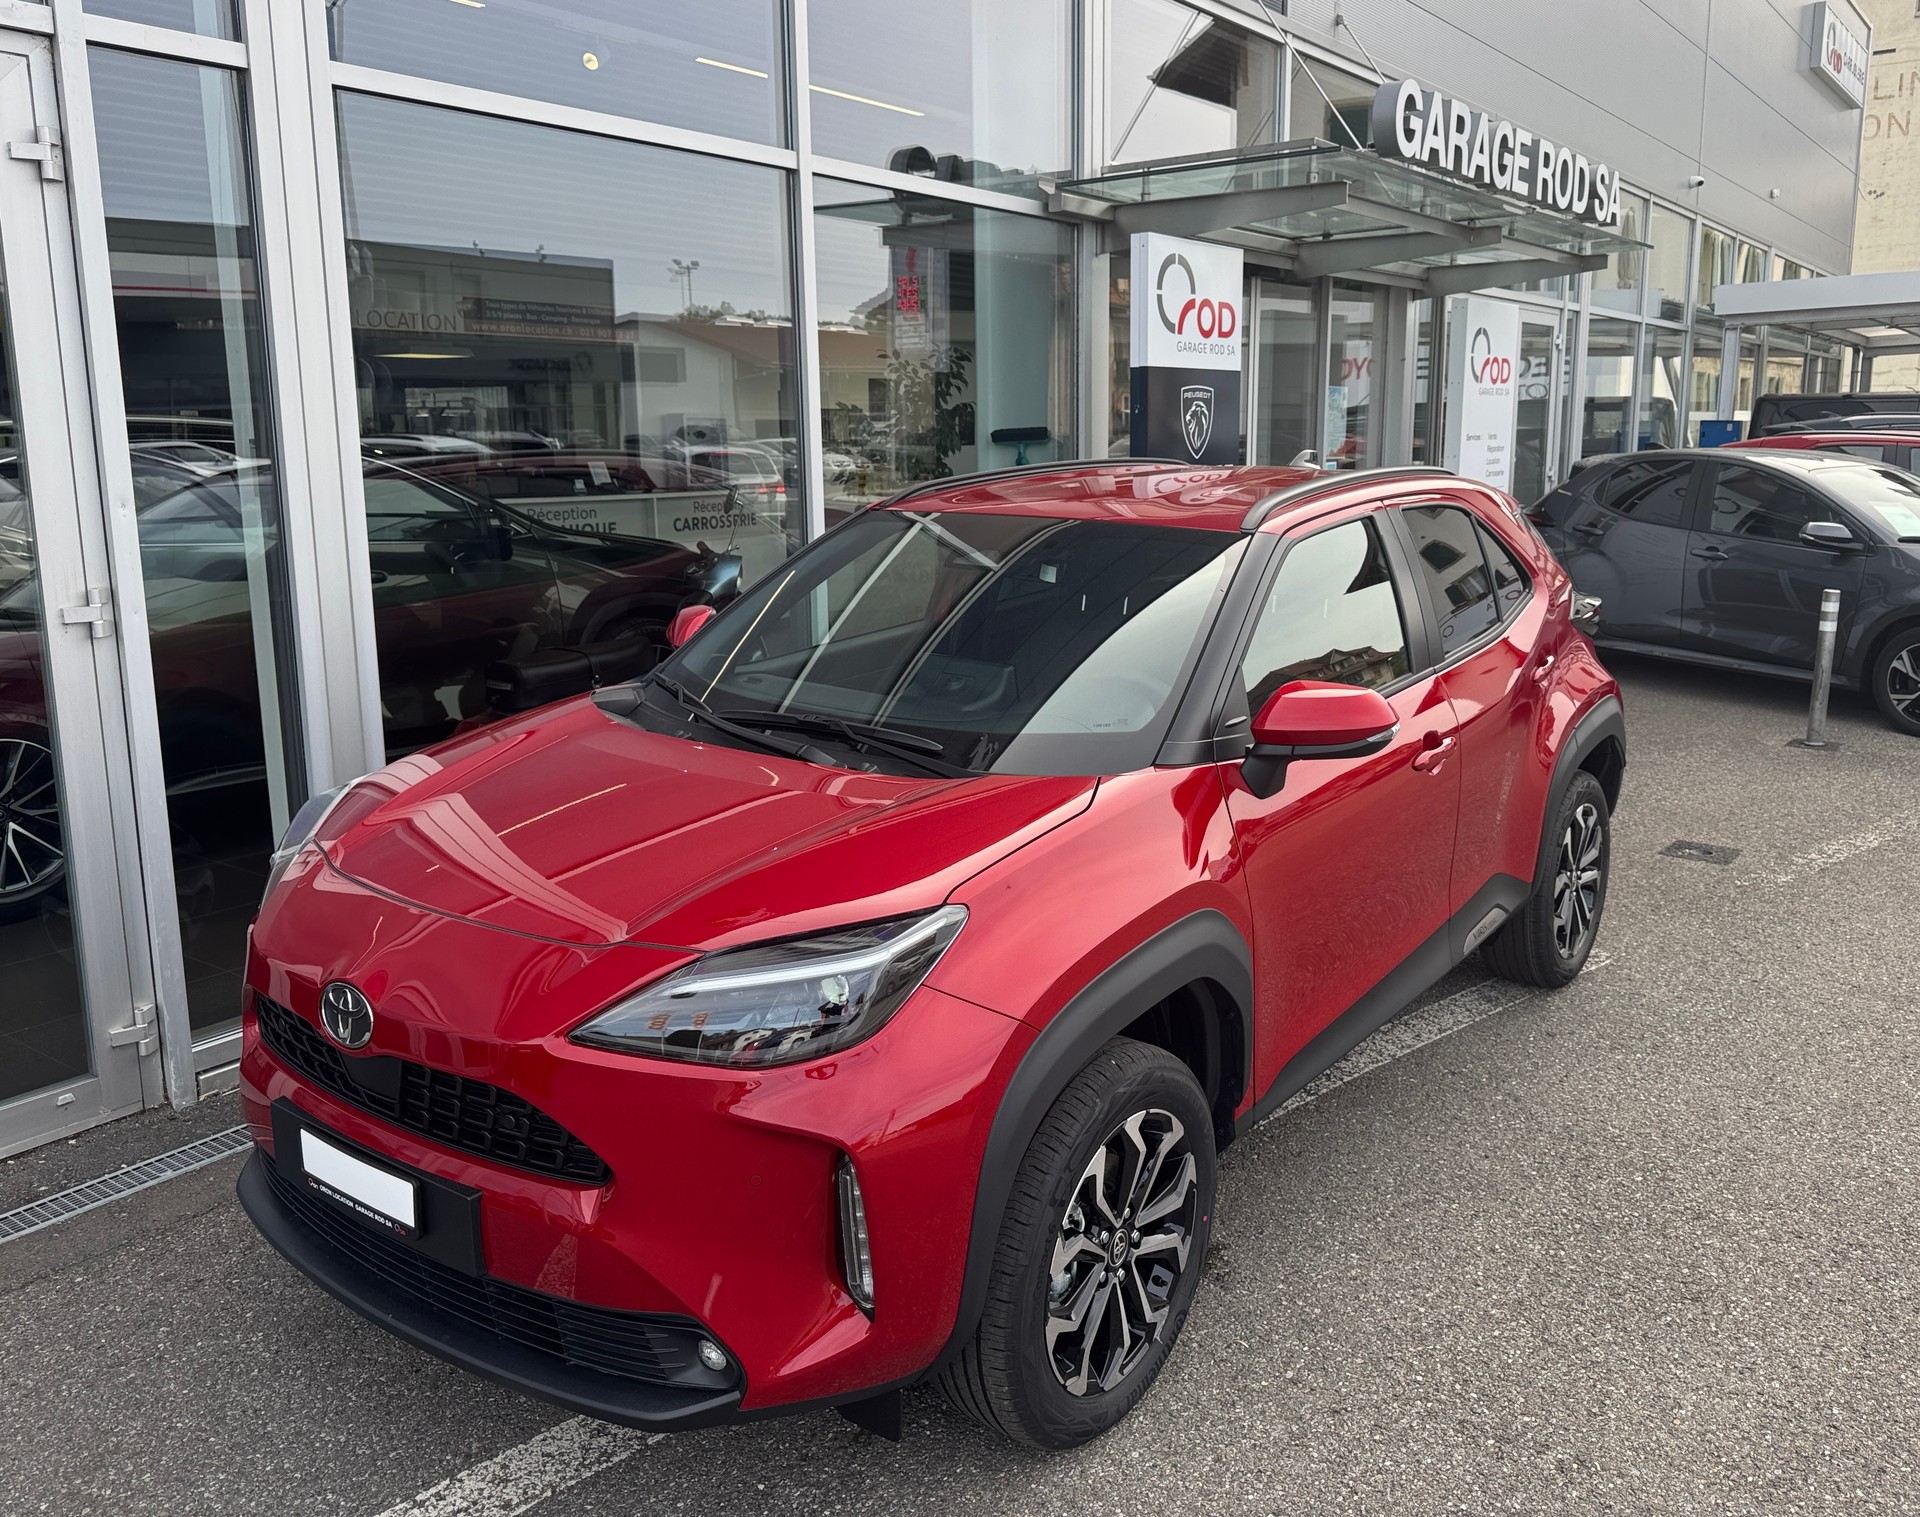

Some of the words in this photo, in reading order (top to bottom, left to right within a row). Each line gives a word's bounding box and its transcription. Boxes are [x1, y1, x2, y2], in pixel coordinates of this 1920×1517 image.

[1395, 78, 1533, 196] GARAGE
[1535, 137, 1590, 214] ROD
[1594, 163, 1621, 227] SA
[355, 309, 458, 332] LOCATION
[1176, 340, 1207, 354] GARAGE
[1209, 343, 1225, 355] ROD
[1226, 345, 1236, 356] SA
[1183, 391, 1212, 399] PEUGEOT
[527, 506, 598, 523] Réception
[673, 512, 757, 533] CARROSSERIE
[332, 1191, 355, 1209] LOCATION
[354, 1203, 375, 1220] GARAGE
